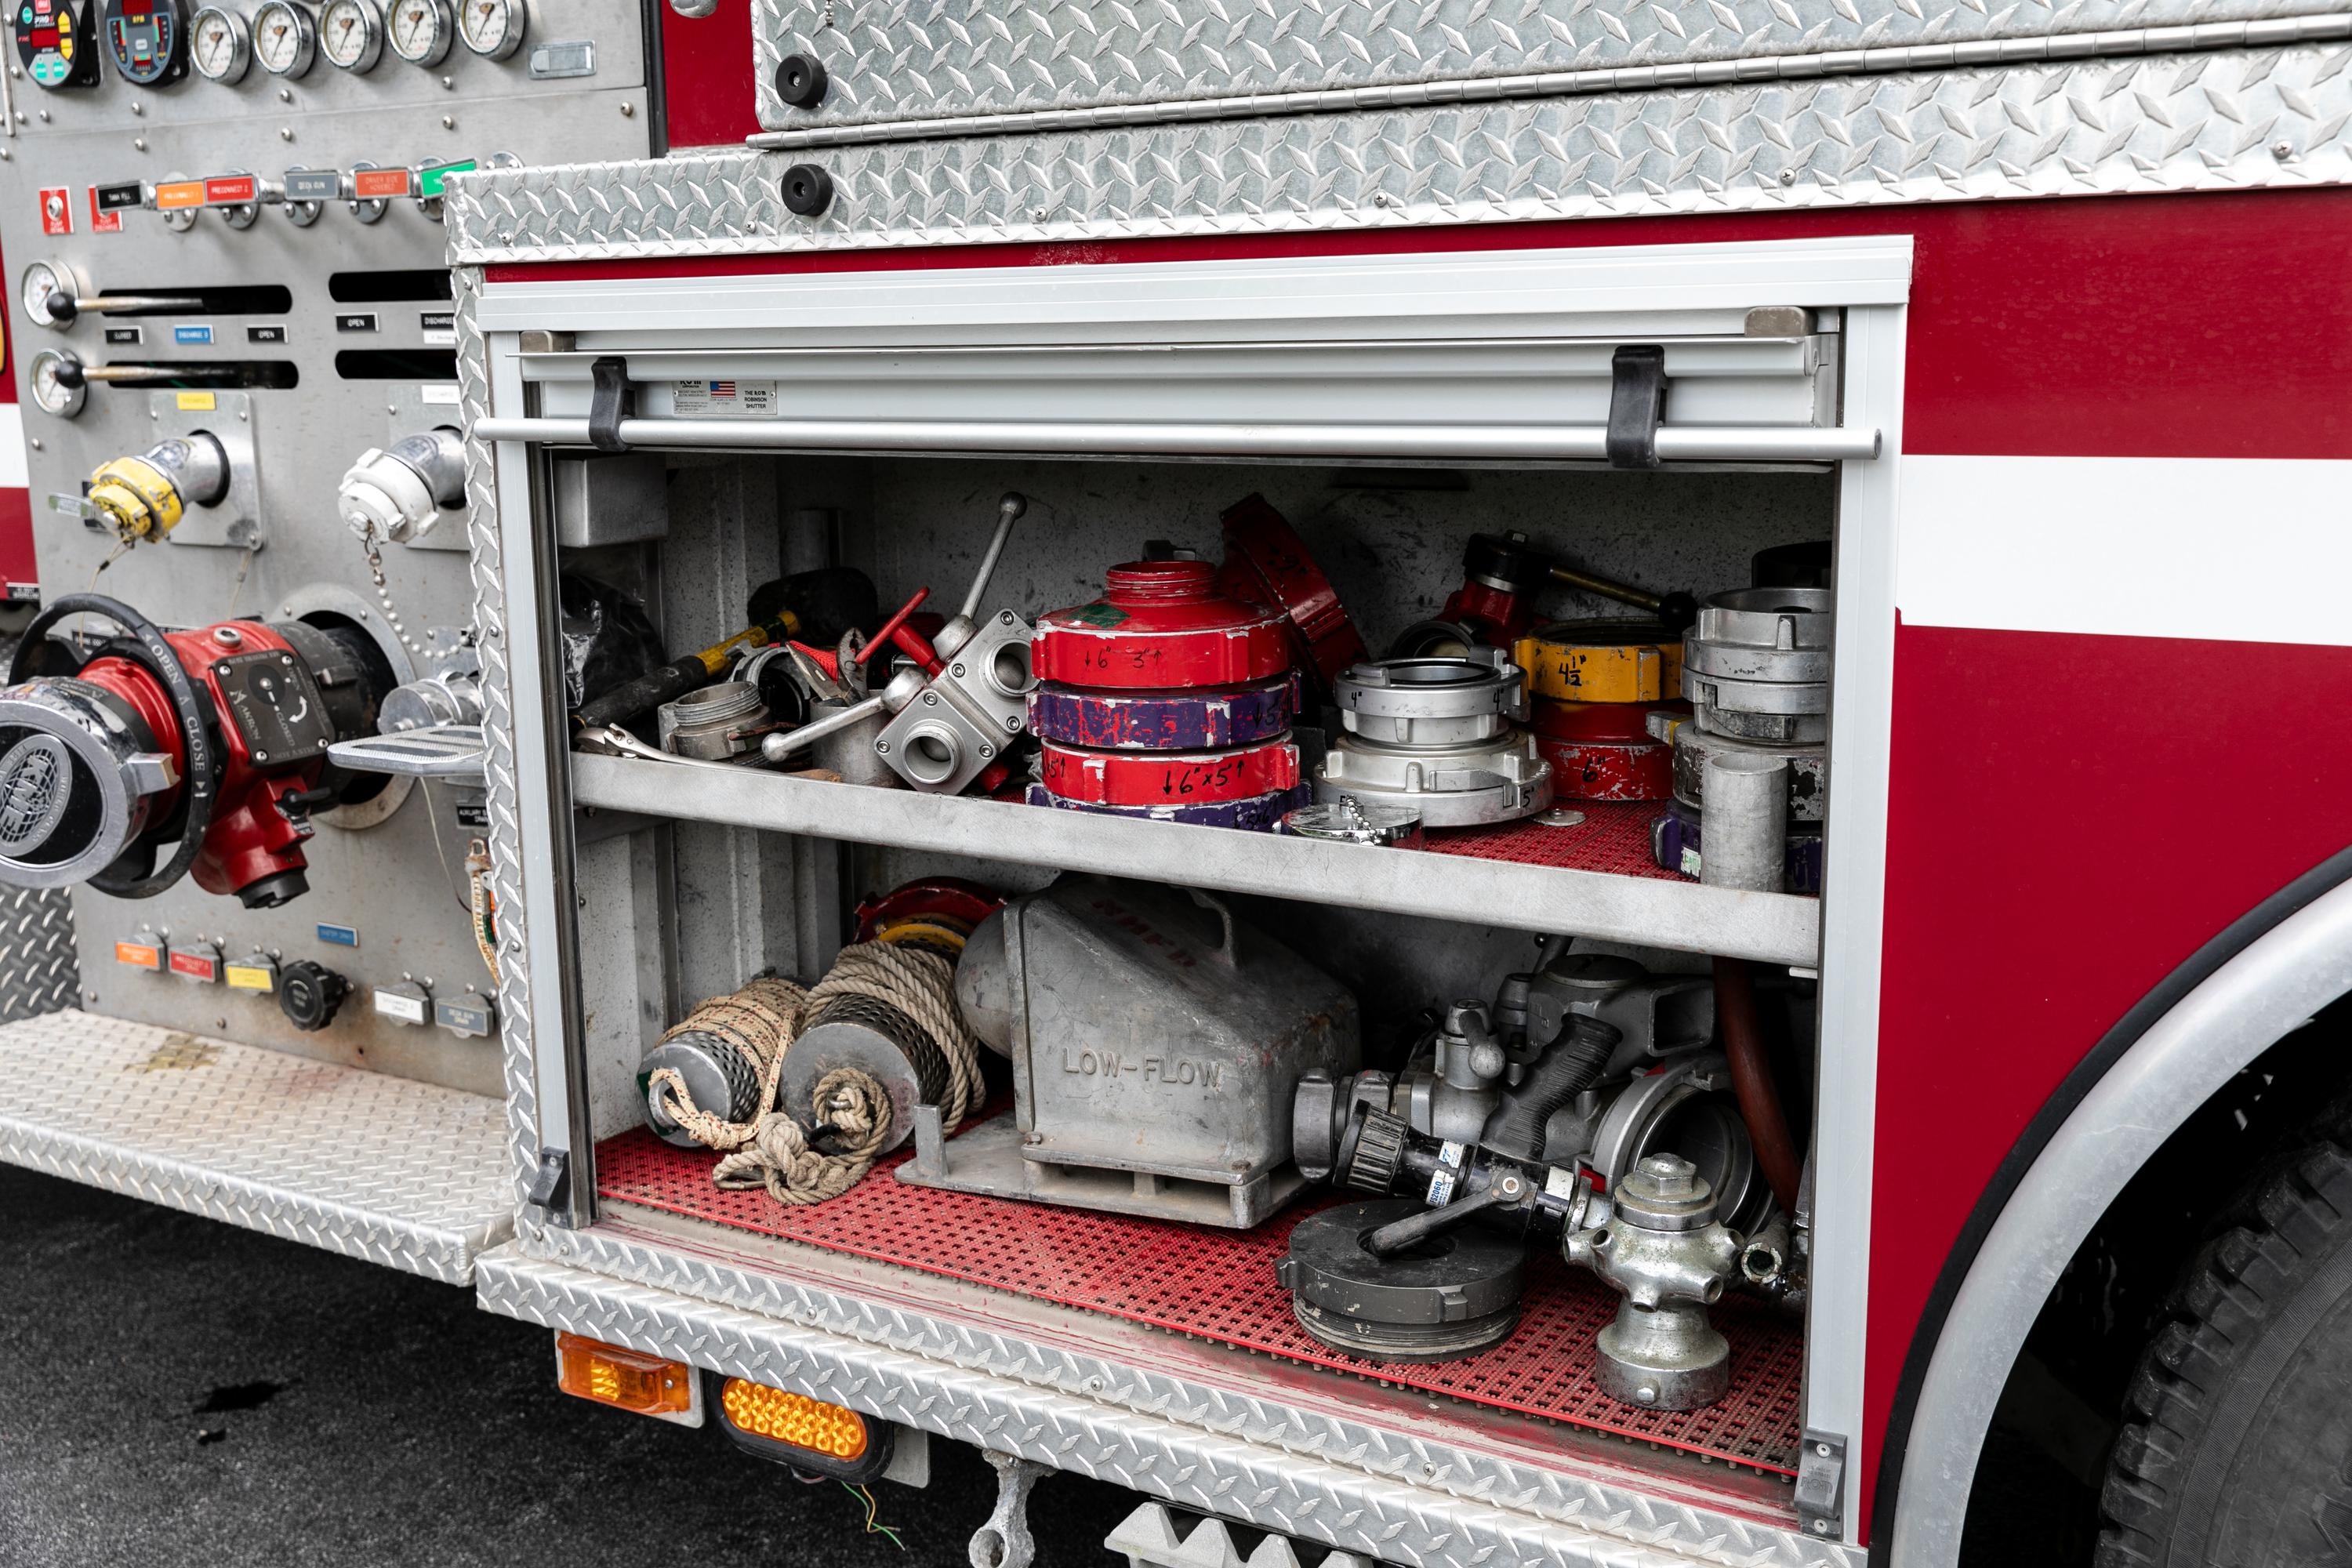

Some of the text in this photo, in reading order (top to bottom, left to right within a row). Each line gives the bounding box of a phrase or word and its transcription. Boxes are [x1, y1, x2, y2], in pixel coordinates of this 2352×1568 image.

[258, 329, 275, 339] OPEN
[347, 318, 365, 328] OPEN
[151, 644, 182, 685] OPEN
[239, 705, 261, 740] AKRON
[276, 711, 296, 746] CLOSED
[187, 716, 207, 773] CLOSE
[1062, 1047, 1222, 1087] LOW-FLOW
[1429, 1181, 1443, 1205] FS2060
